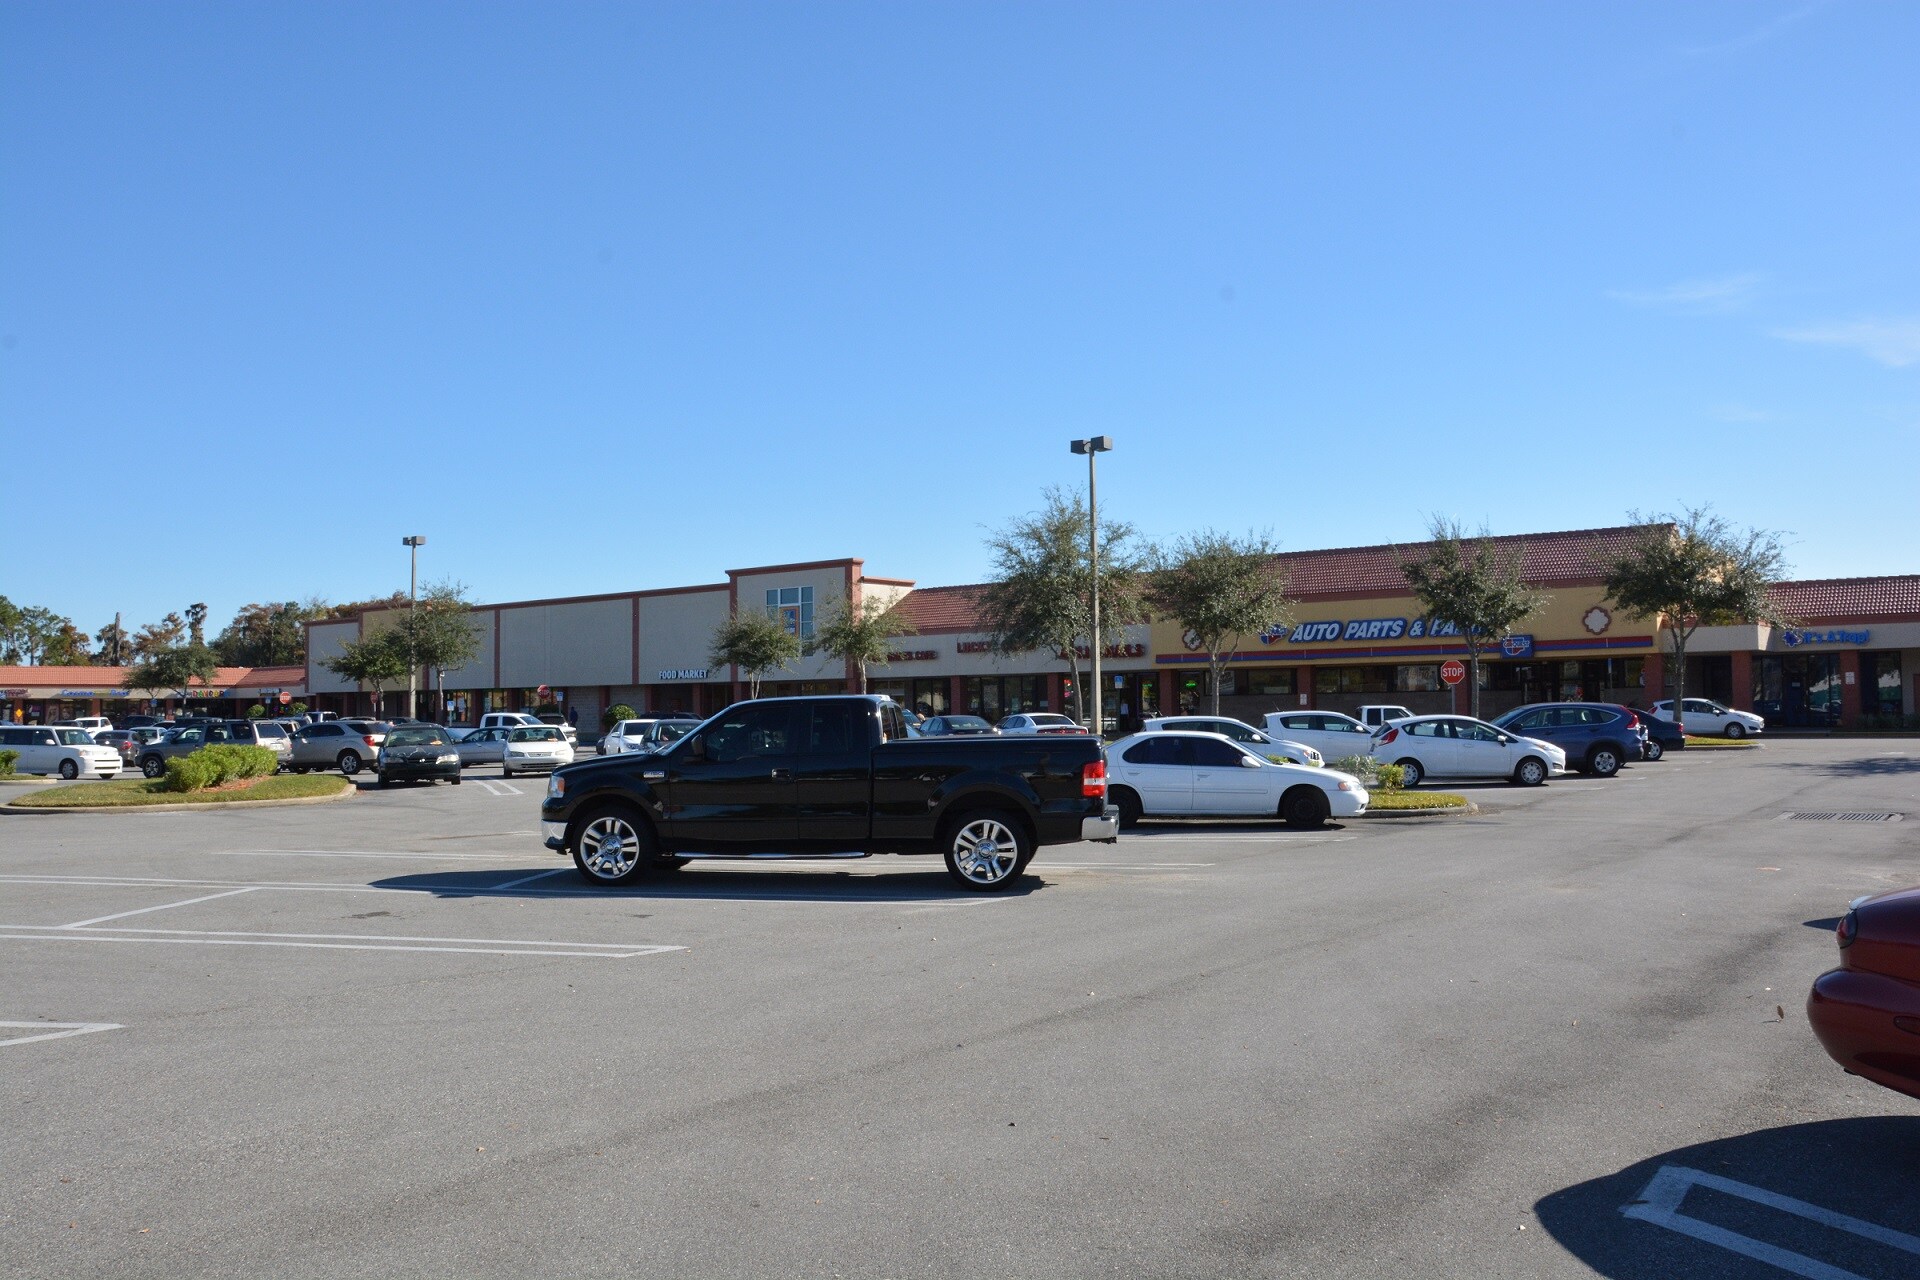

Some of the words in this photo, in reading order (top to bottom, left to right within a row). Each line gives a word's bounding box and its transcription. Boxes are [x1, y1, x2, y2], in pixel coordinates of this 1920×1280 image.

[1290, 623, 1340, 641] AUTO
[1345, 620, 1404, 639] PARTS
[1409, 620, 1423, 636] &
[659, 671, 677, 679] FOOD
[678, 669, 708, 679] MARKET
[1442, 667, 1463, 677] STOP
